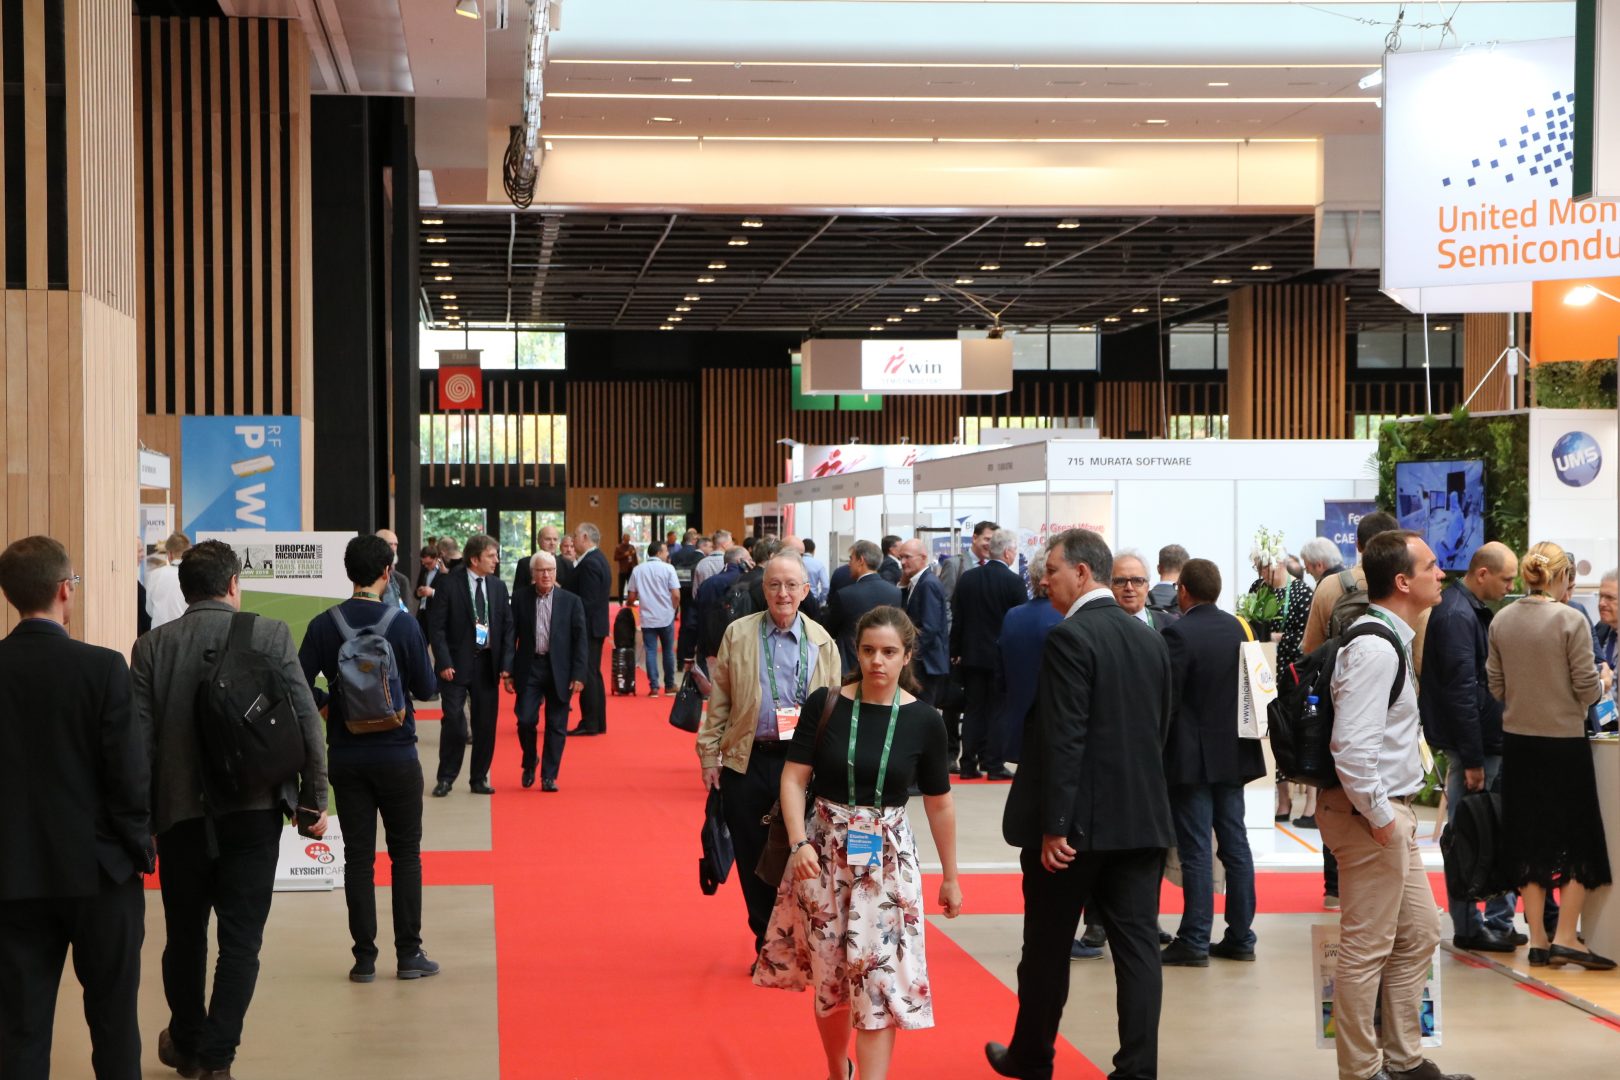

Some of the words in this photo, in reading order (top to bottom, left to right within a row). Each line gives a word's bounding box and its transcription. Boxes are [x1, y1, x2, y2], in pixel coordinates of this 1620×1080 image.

[1438, 199, 1537, 233] United
[908, 360, 942, 374] win
[267, 425, 282, 448] RF
[1067, 457, 1085, 466] 715
[1090, 457, 1133, 466] MURATA
[1136, 457, 1192, 466] SOFTWARE
[1555, 446, 1599, 472] UMS
[630, 497, 682, 510] SORTIE
[1334, 533, 1356, 544] CAE
[275, 544, 316, 553] EUROPEAN
[275, 552, 316, 560] MICROWAVE
